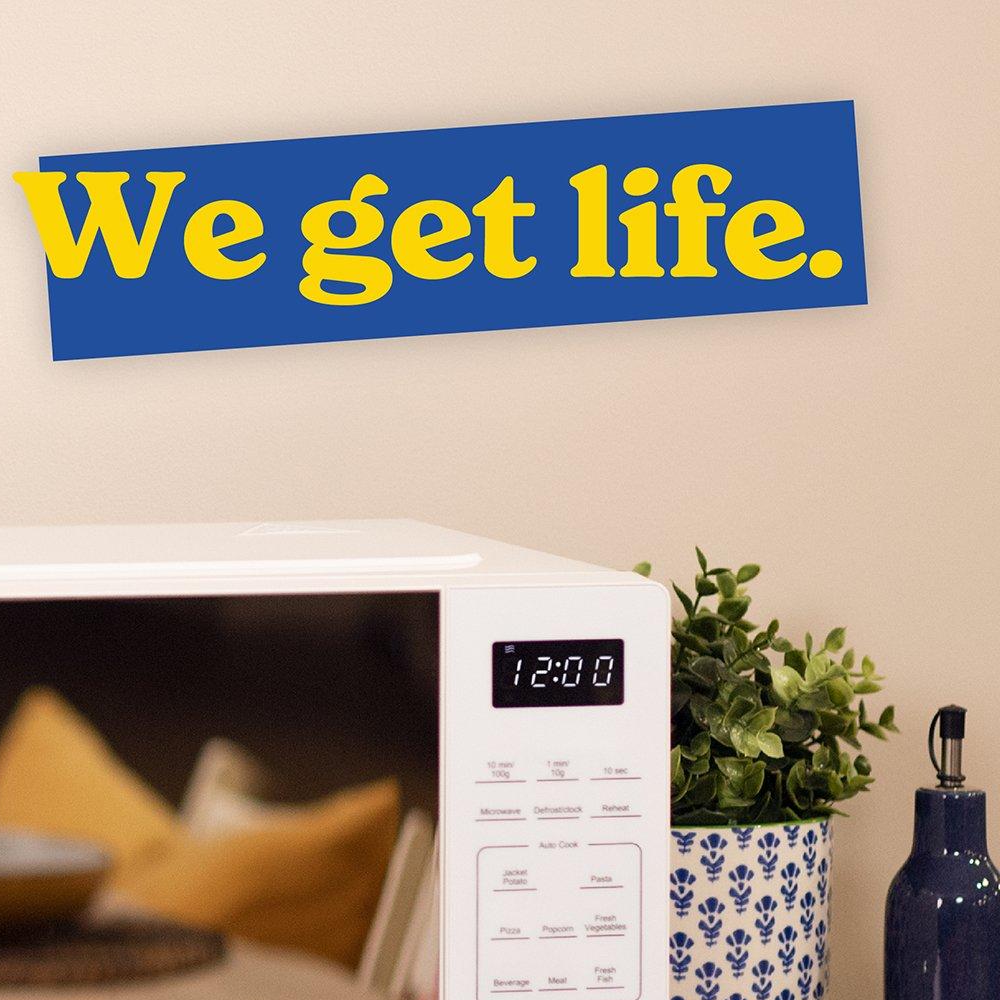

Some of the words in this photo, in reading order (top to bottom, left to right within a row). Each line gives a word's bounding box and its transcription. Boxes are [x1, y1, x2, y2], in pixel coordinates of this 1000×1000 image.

[513, 655, 615, 688] 12:00
[487, 761, 497, 769] 10
[491, 770, 511, 779] 100g
[551, 768, 566, 779] 10g
[603, 767, 614, 775] 10
[614, 767, 629, 775] sec
[480, 807, 522, 816] Microwave
[601, 804, 630, 813] Reheat
[538, 840, 557, 849] Auto
[558, 840, 579, 849] Cook
[502, 868, 528, 877] Jacket
[502, 877, 528, 886] Potato
[590, 874, 613, 883] Pasta
[594, 914, 617, 923] Fresh
[499, 926, 522, 935] Pizza
[542, 924, 575, 935] Popcorn
[584, 922, 628, 933] Vegetables
[594, 965, 617, 975] Fresh
[493, 976, 531, 988] Beverage
[547, 975, 568, 985] Meat
[597, 974, 614, 983] Fish
